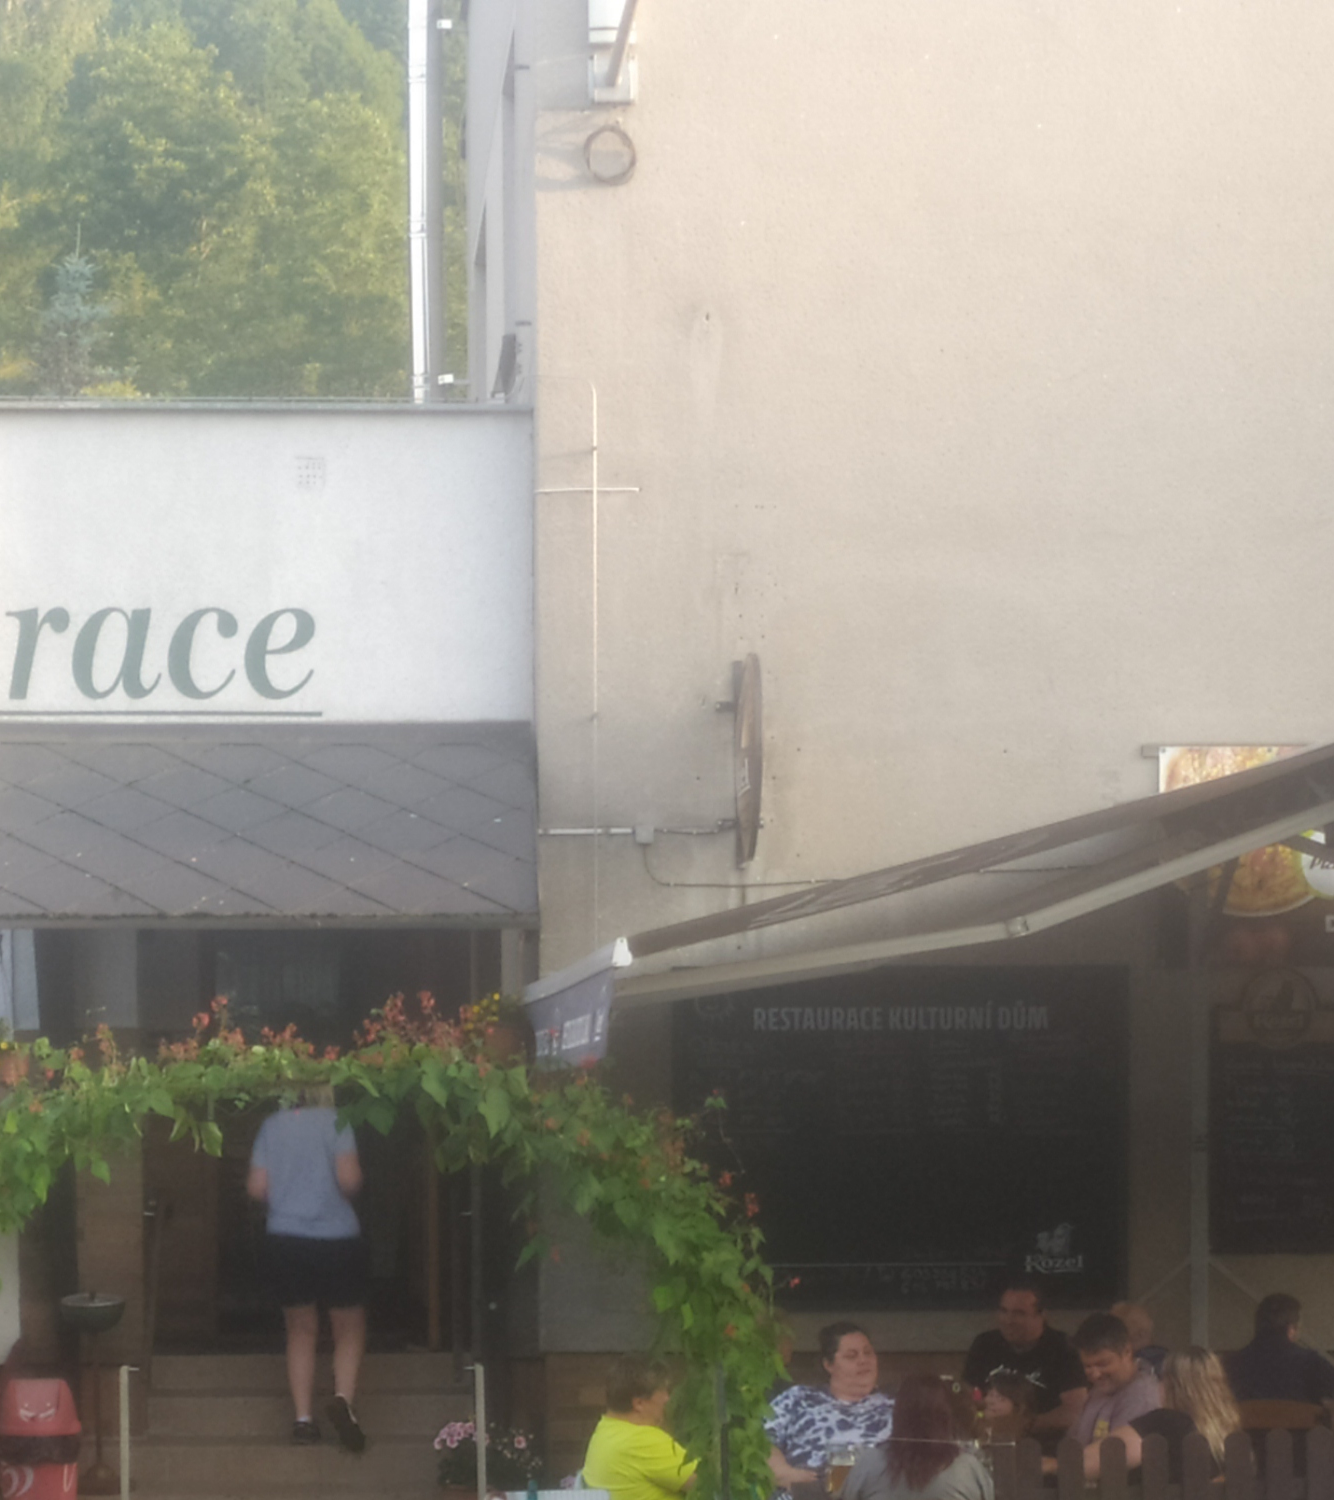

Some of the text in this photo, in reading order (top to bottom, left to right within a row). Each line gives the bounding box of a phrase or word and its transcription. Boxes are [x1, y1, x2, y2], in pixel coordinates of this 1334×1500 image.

[753, 1000, 1049, 1031] RESTAURACE KULTURNÍ DŮM
[1024, 1254, 1084, 1274] Kozel
